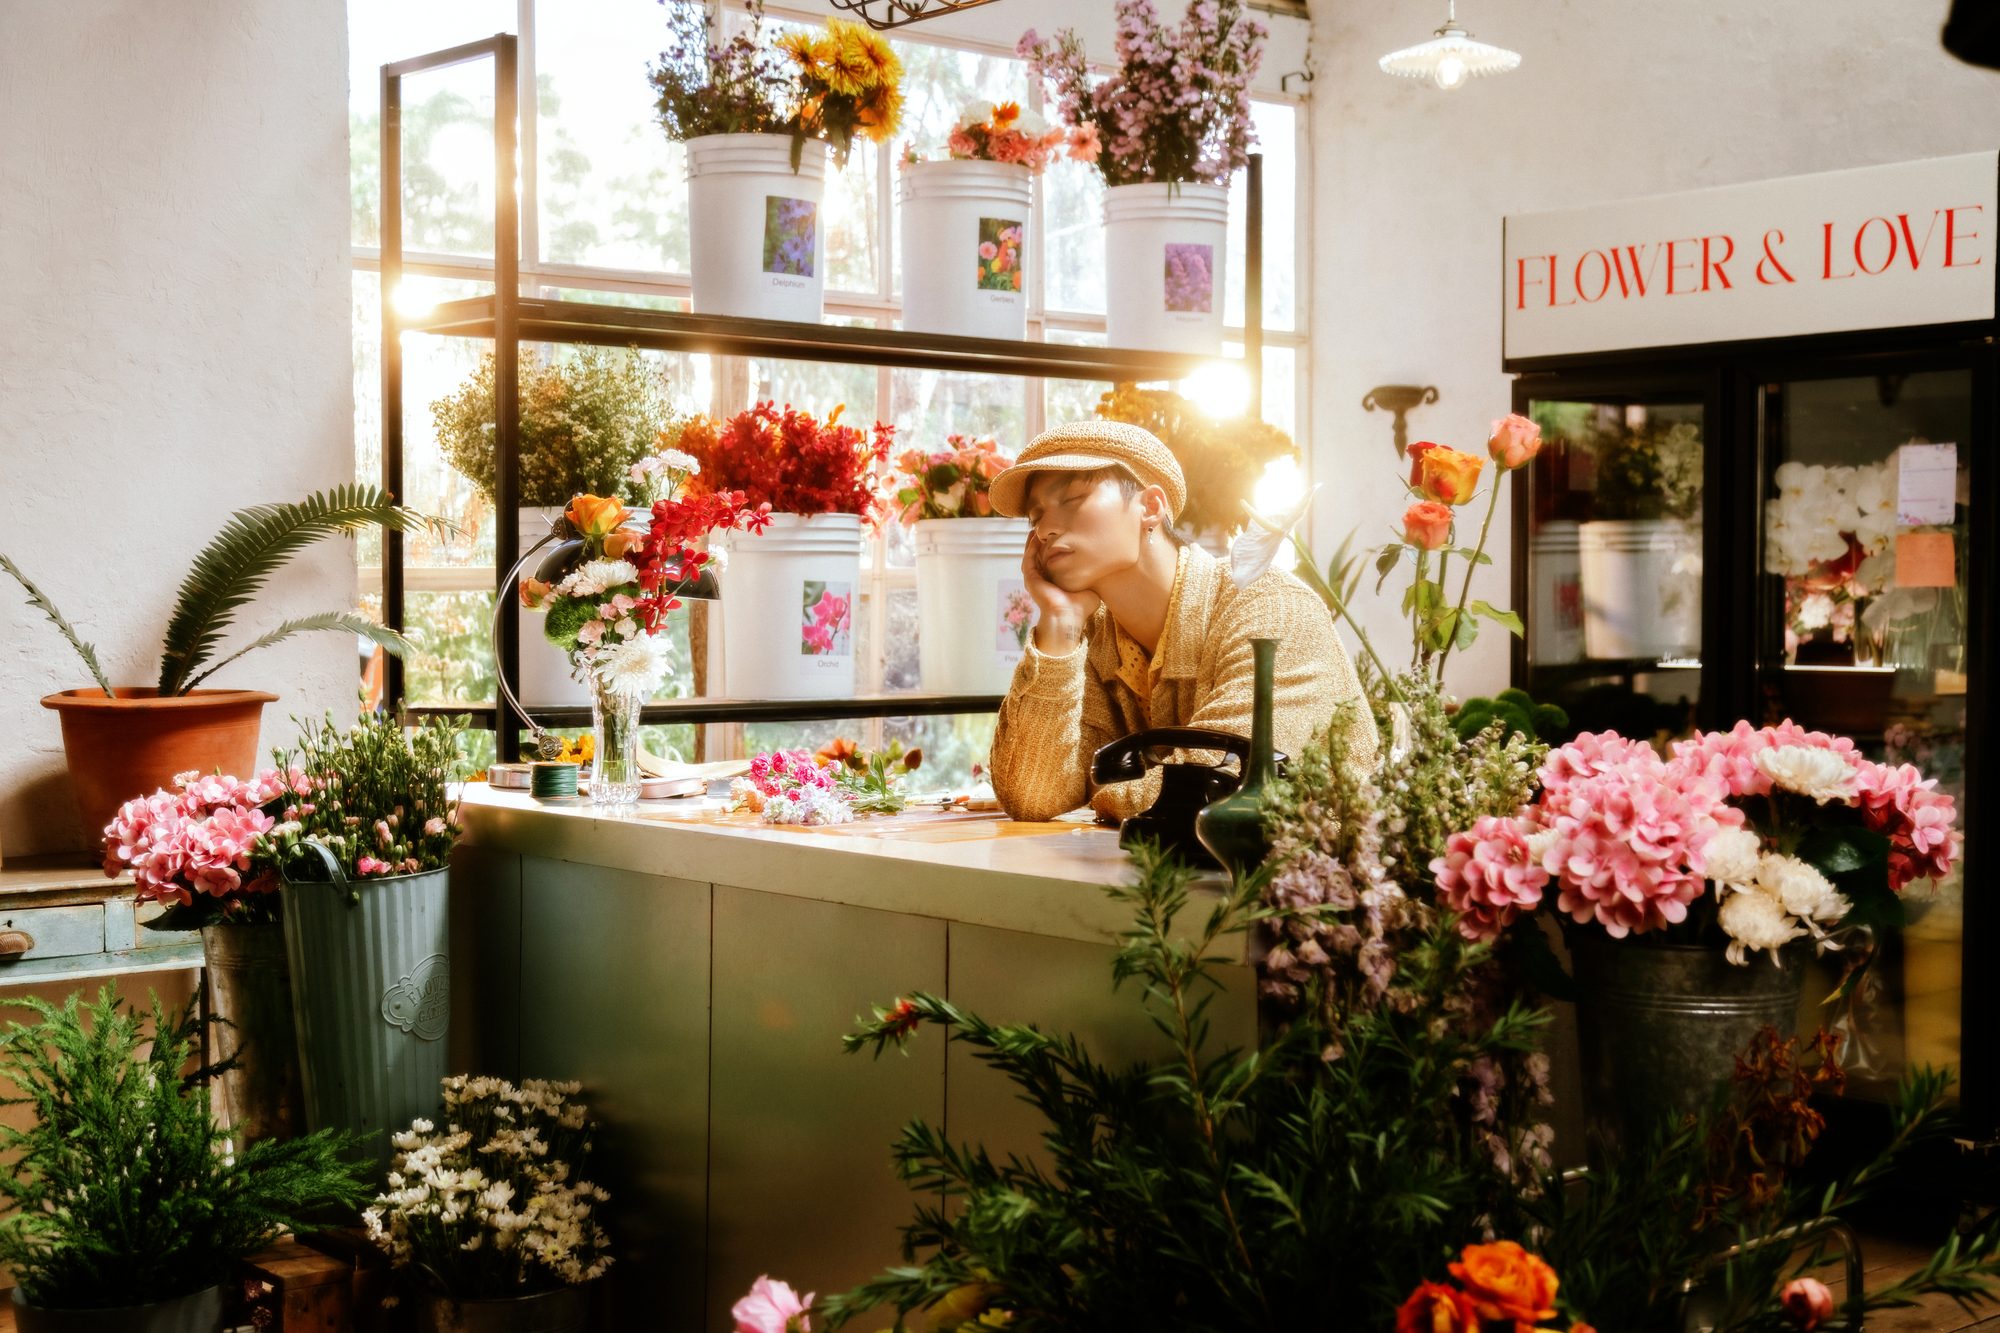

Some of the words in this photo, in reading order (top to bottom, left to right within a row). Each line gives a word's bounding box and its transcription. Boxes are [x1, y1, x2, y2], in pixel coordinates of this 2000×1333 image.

[1516, 234, 1734, 310] FLOWER
[1755, 228, 1797, 286] &
[1821, 204, 1984, 281] LOVE
[817, 659, 839, 667] Orchid
